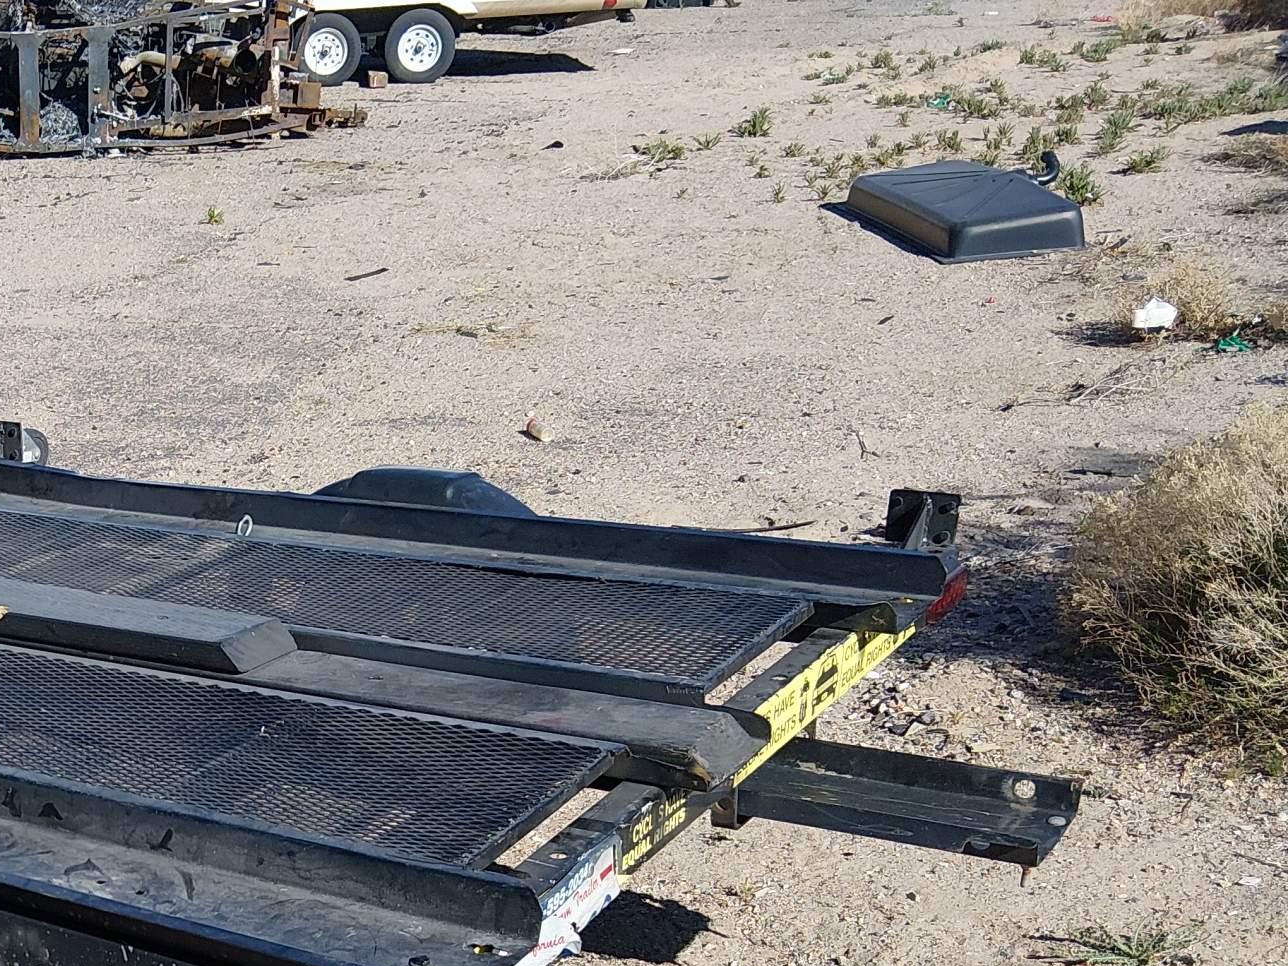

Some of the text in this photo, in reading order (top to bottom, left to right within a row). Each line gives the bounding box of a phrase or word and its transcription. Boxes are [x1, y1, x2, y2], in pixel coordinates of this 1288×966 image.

[866, 635, 892, 668] RIGHTS
[773, 690, 796, 718] HAVE
[622, 807, 687, 871] EQUAL RIGHTS
